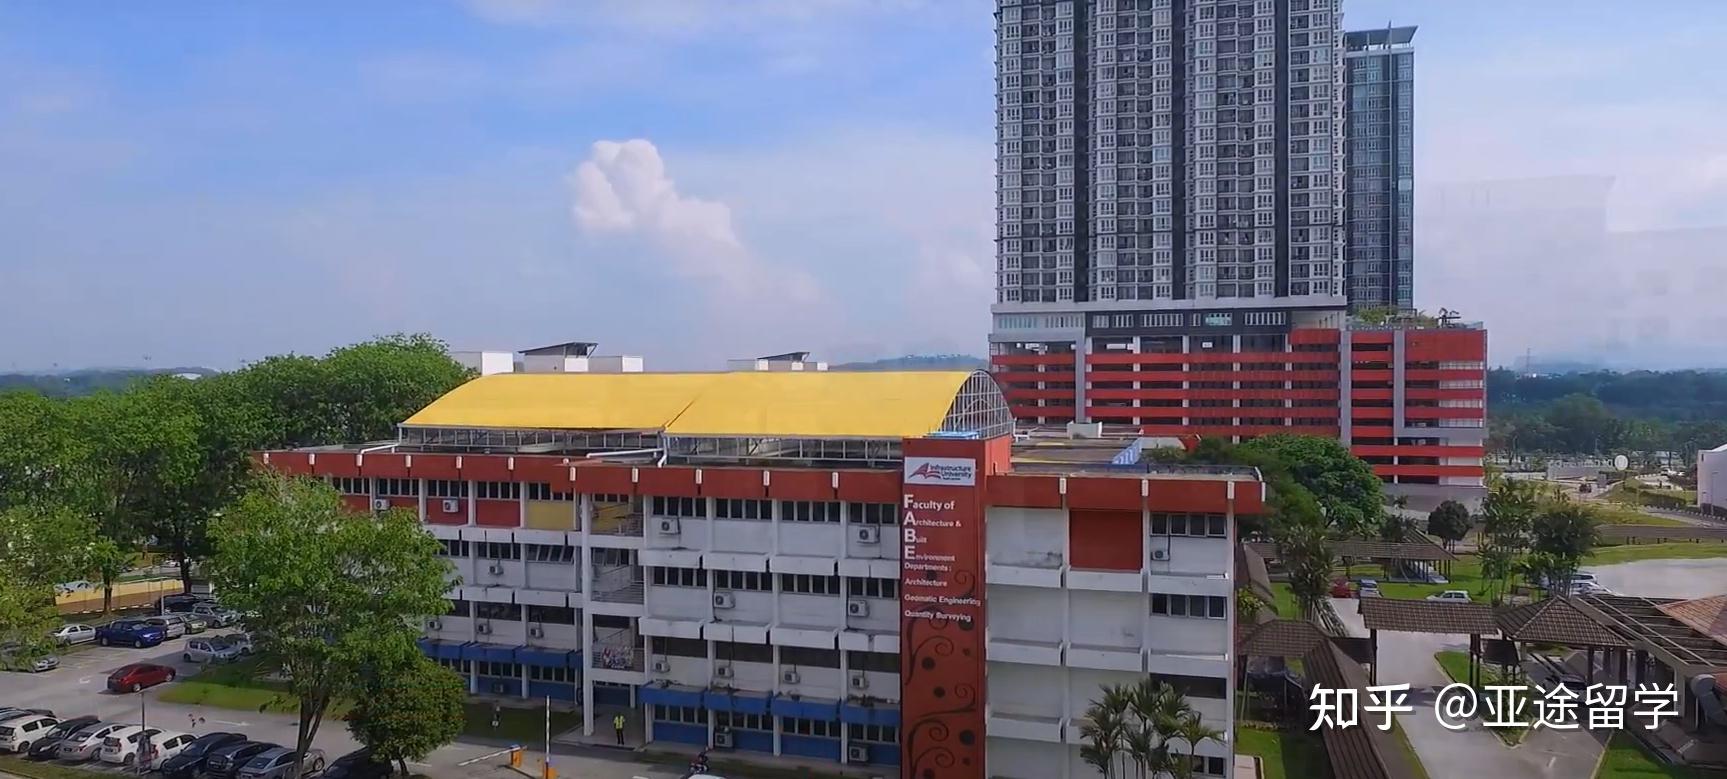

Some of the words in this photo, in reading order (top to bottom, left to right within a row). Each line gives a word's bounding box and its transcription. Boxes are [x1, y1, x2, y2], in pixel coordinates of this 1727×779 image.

[941, 469, 972, 479] University
[904, 494, 942, 511] Faculty
[943, 500, 955, 510] of
[905, 578, 948, 587] Architecture
[939, 596, 981, 607] Engineering
